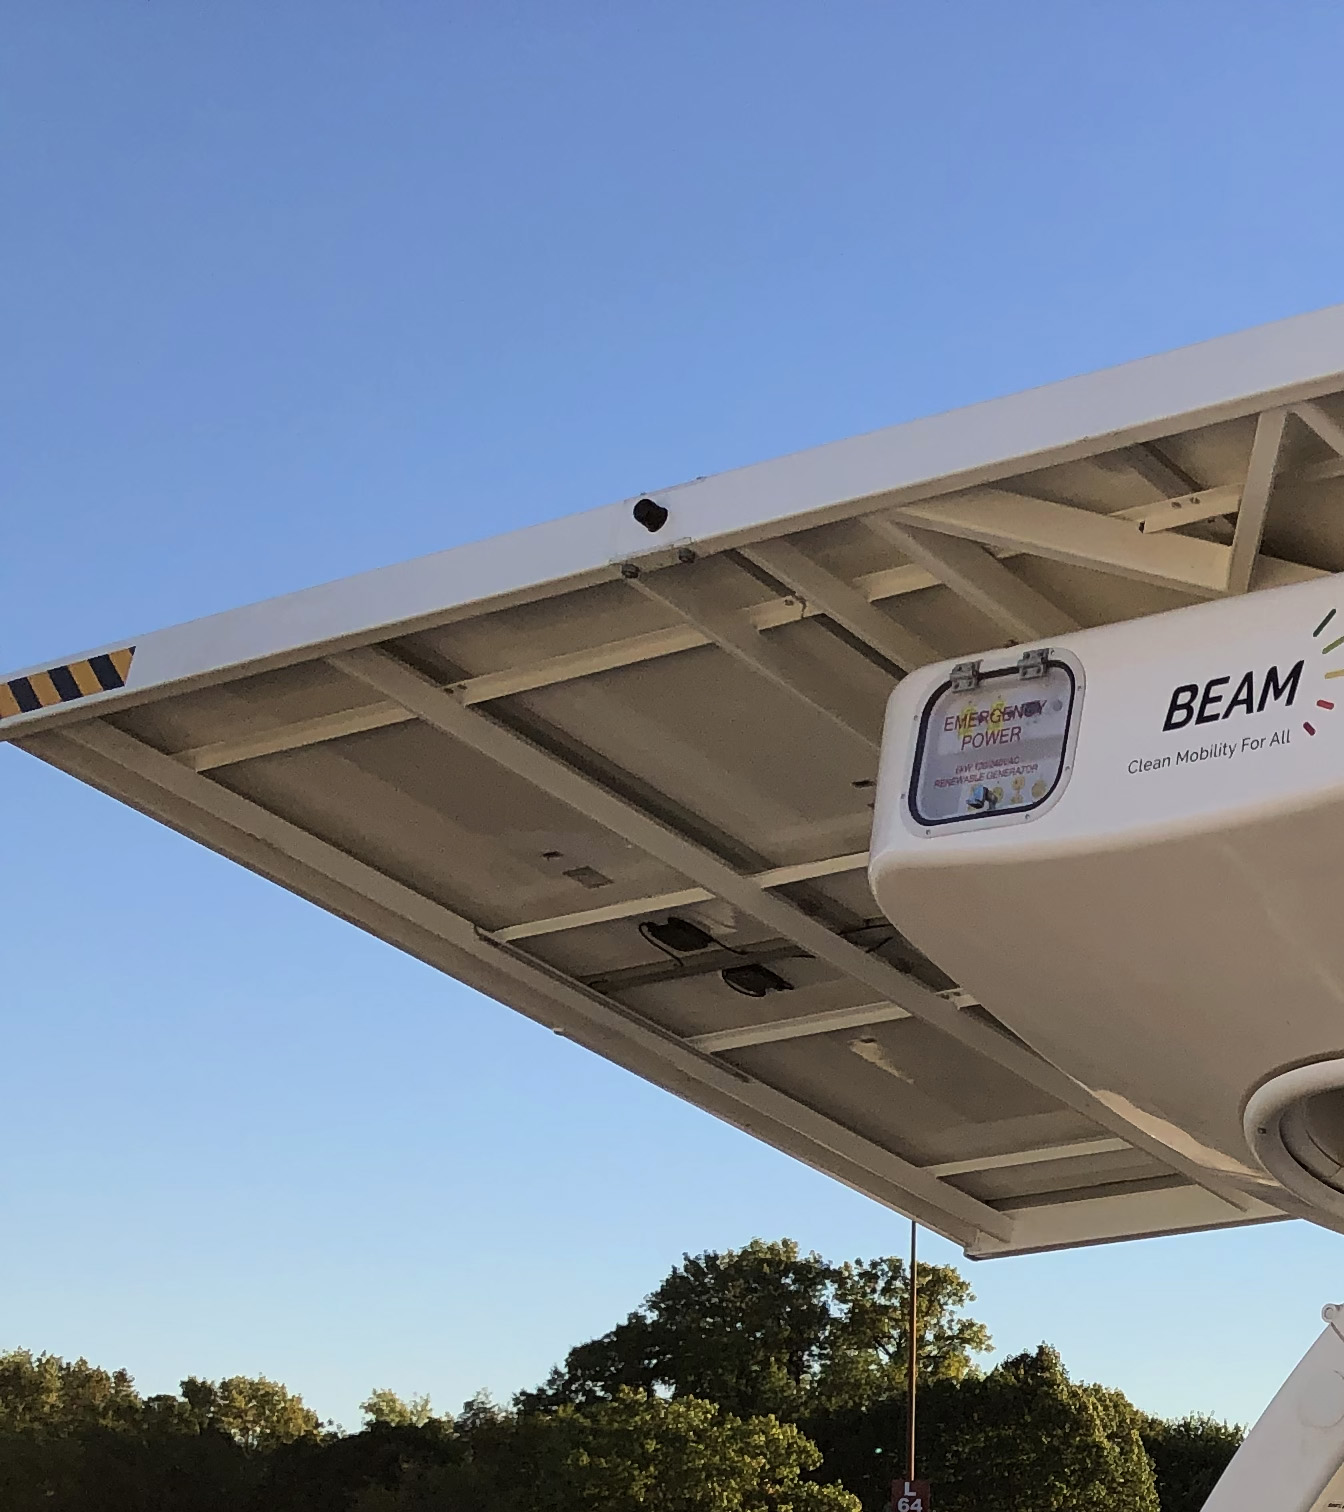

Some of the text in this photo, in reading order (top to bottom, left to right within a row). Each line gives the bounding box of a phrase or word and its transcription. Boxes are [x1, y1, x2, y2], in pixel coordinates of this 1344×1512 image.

[1162, 660, 1305, 732] BEAM
[943, 699, 1048, 732] EMERGENCY
[960, 726, 1022, 751] POWER
[1128, 729, 1290, 774] Clean Mobility For All
[904, 1481, 917, 1497] L
[897, 1497, 923, 1512] 64
